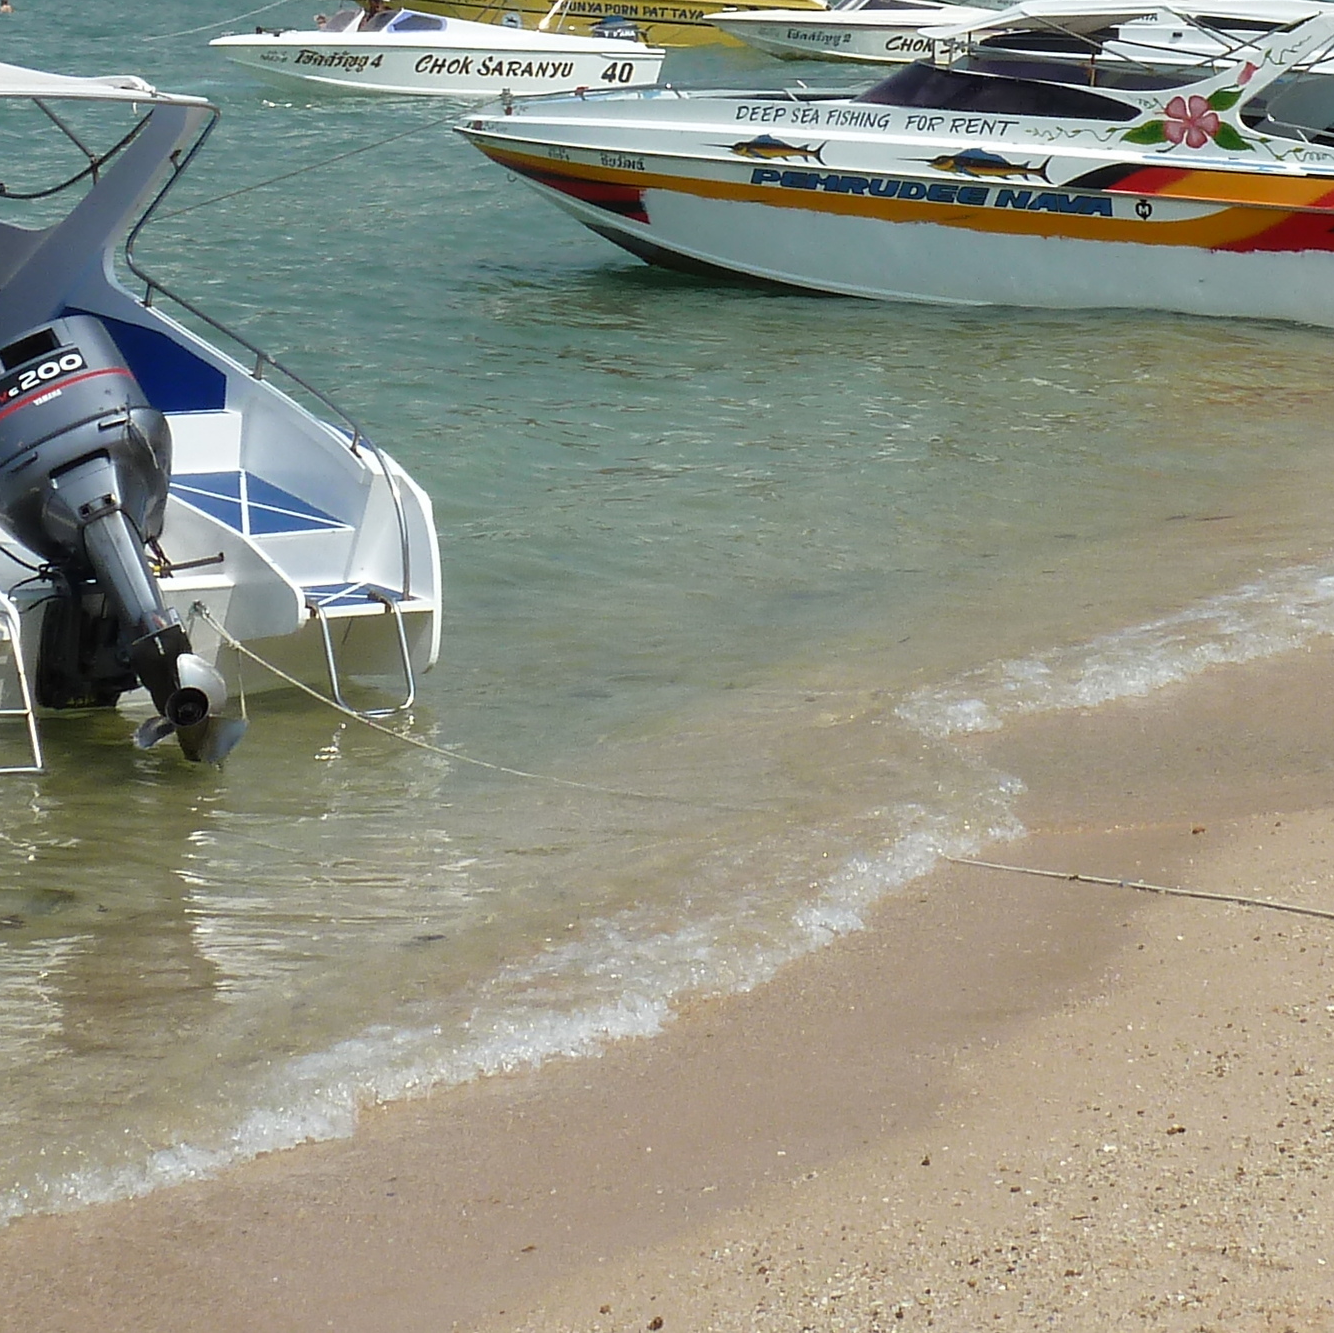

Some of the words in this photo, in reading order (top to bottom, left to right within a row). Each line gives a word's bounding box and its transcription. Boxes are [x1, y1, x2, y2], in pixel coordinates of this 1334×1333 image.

[643, 6, 704, 20] PATTAYA
[370, 53, 384, 68] 4
[415, 54, 474, 74] CHOK
[477, 55, 574, 79] SARANYU
[601, 61, 635, 83] 40
[735, 105, 786, 123] DEEP
[791, 107, 818, 124] SEA
[825, 109, 891, 131] FISHING
[904, 115, 946, 133] FOR
[949, 118, 1020, 137] RENT
[750, 168, 990, 206] PEMRUDEE
[994, 189, 1113, 217] NAVA
[18, 353, 83, 391] 200
